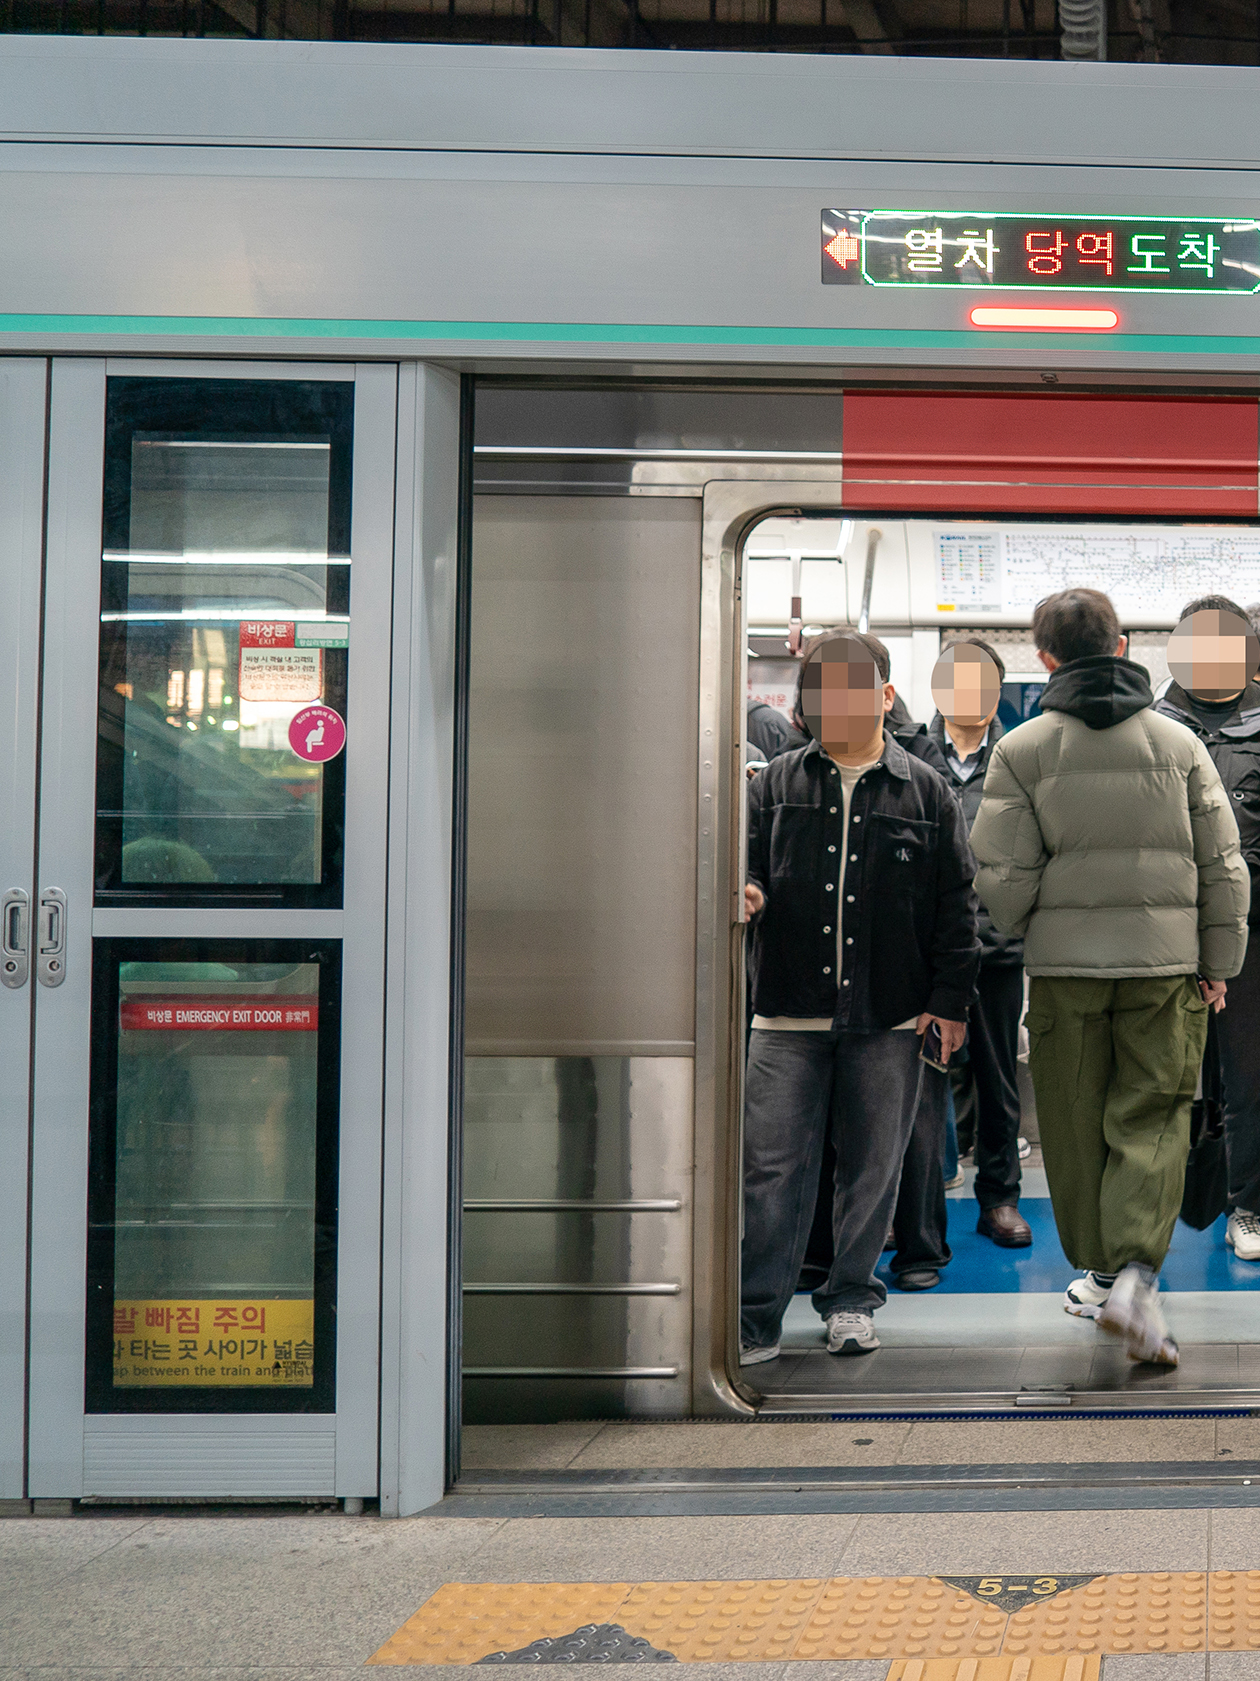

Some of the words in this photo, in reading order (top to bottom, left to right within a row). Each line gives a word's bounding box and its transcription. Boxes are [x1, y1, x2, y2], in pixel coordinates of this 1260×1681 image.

[904, 228, 1000, 274] 열차
[1025, 231, 1113, 275] 당역
[1126, 233, 1220, 278] 도착
[247, 624, 287, 638] 비상문
[148, 1010, 172, 1023] 비상문
[176, 1010, 230, 1023] EMERGENCY
[233, 1010, 252, 1023] EXIT
[254, 1011, 282, 1023] DOOR
[285, 1011, 310, 1024] 非常門
[114, 1308, 138, 1334] 발
[145, 1307, 200, 1334] 빠짐
[213, 1306, 266, 1334] 주의
[130, 1340, 171, 1360] 타는
[178, 1340, 198, 1360] 곳
[204, 1339, 267, 1360] 사이가
[133, 1365, 190, 1376] between
[194, 1365, 216, 1376] the
[221, 1365, 250, 1376] train
[255, 1365, 280, 1376] and
[976, 1578, 1058, 1596] 5-3
